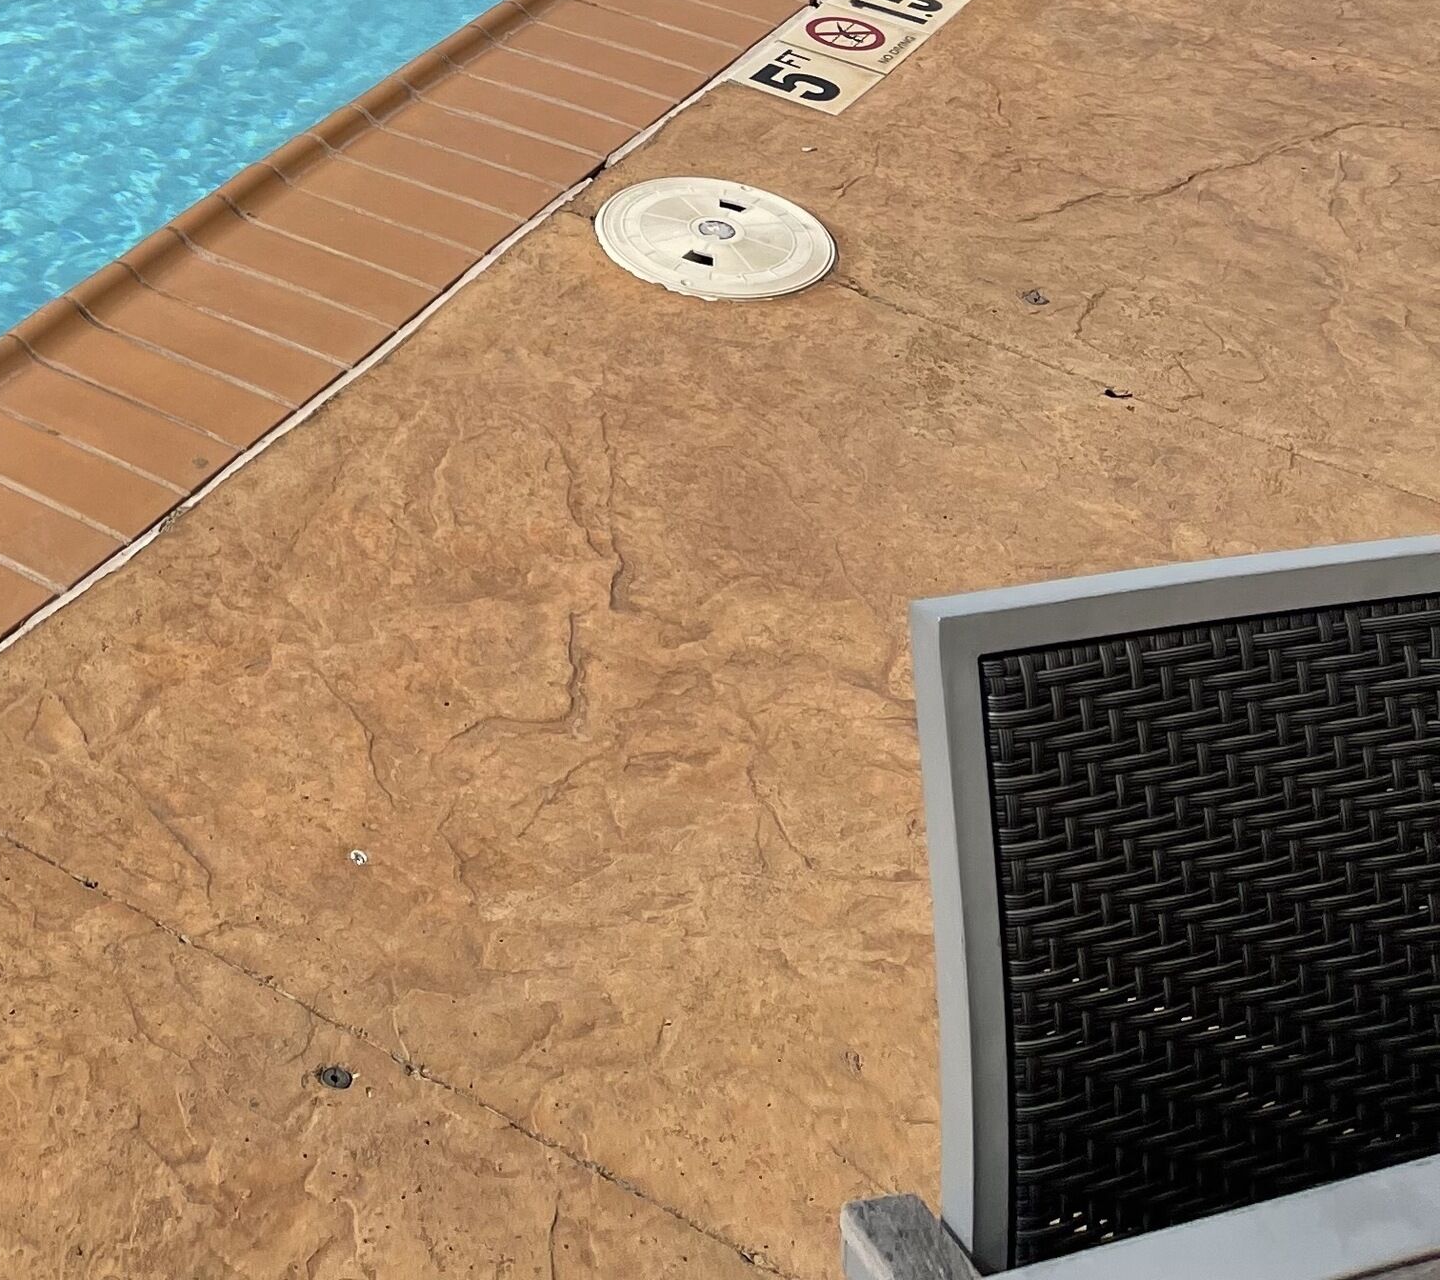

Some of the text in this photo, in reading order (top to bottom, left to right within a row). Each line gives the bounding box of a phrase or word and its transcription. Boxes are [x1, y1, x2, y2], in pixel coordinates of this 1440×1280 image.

[878, 53, 894, 65] NO
[749, 49, 841, 102] 5 FT
